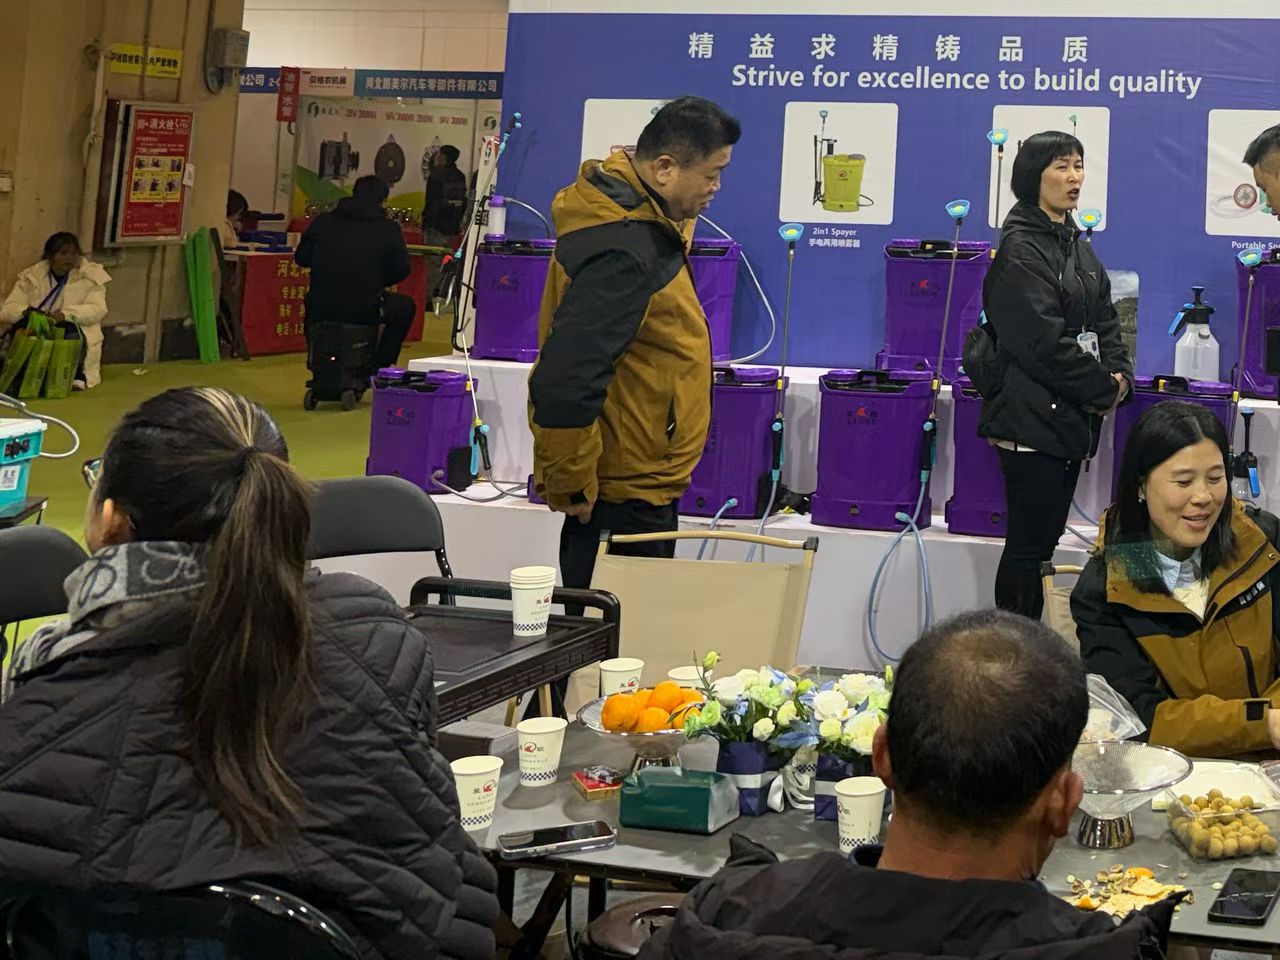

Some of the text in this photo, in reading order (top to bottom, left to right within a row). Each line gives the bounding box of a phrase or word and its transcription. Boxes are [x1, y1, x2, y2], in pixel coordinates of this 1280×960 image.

[688, 32, 1088, 63] 精益求精铸品质
[732, 63, 1202, 100] Strive for excellence to build quality
[812, 227, 857, 238] 2in1 Spayer
[1231, 241, 1266, 250] Portable
